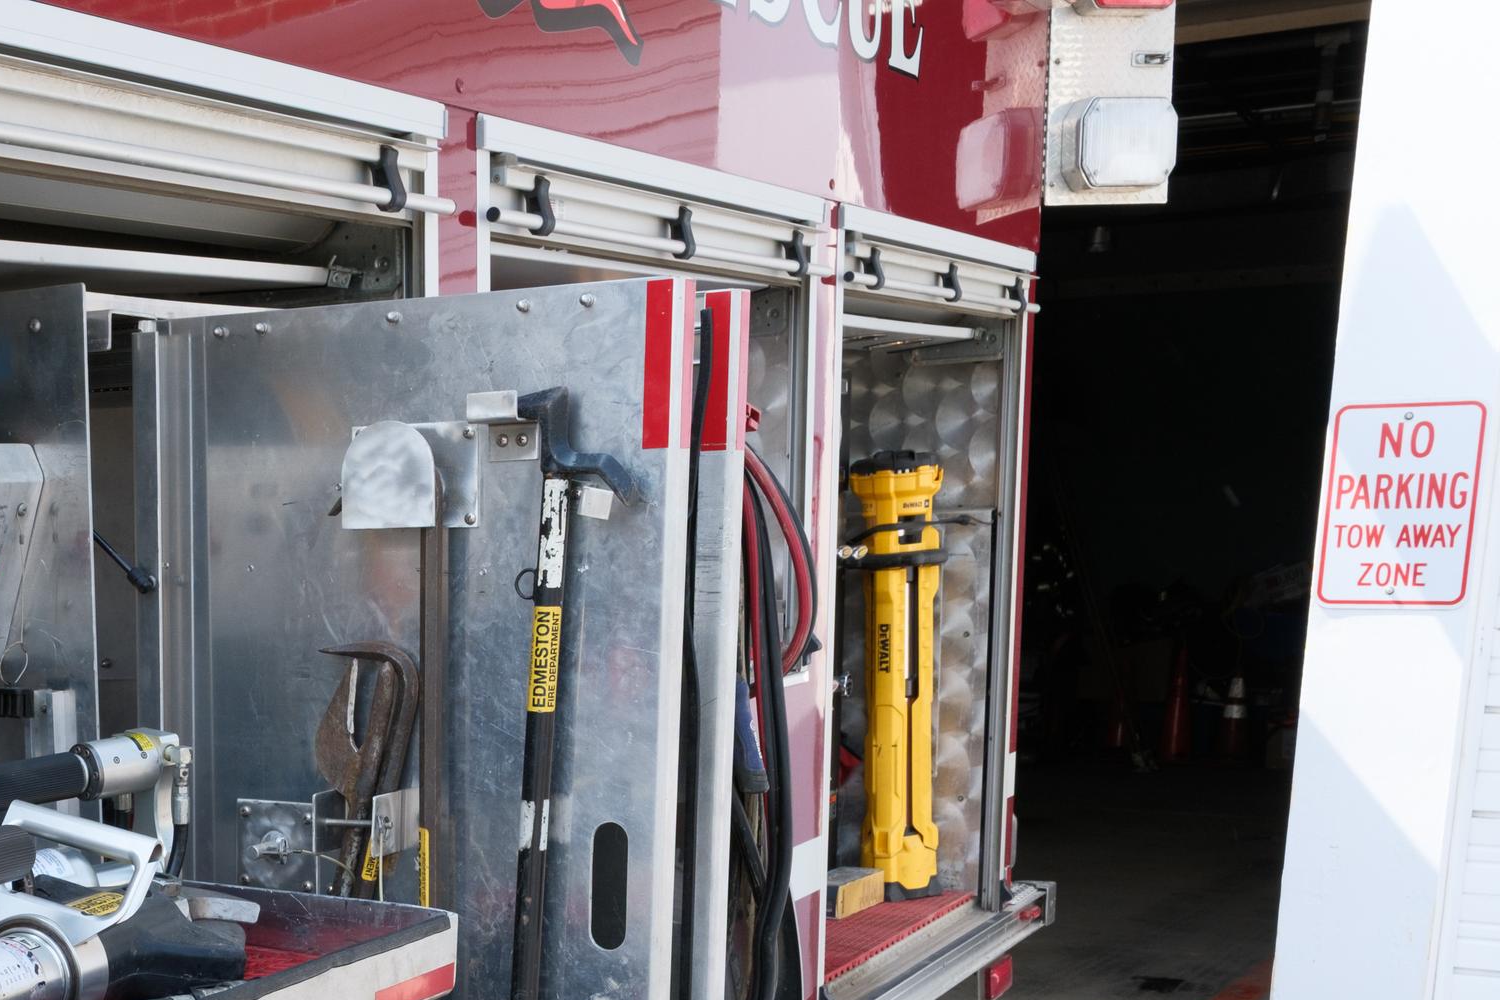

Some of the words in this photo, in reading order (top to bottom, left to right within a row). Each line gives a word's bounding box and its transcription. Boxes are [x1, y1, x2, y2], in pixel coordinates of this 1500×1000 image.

[1378, 421, 1435, 458] NO
[1335, 471, 1470, 510] PARKING
[1334, 524, 1385, 548] TOW
[1396, 523, 1462, 548] AWAY
[1357, 563, 1427, 587] ZONE
[532, 611, 550, 708] EDMESTON
[548, 611, 560, 682] DEPARTMENT
[547, 685, 556, 708] FIRE
